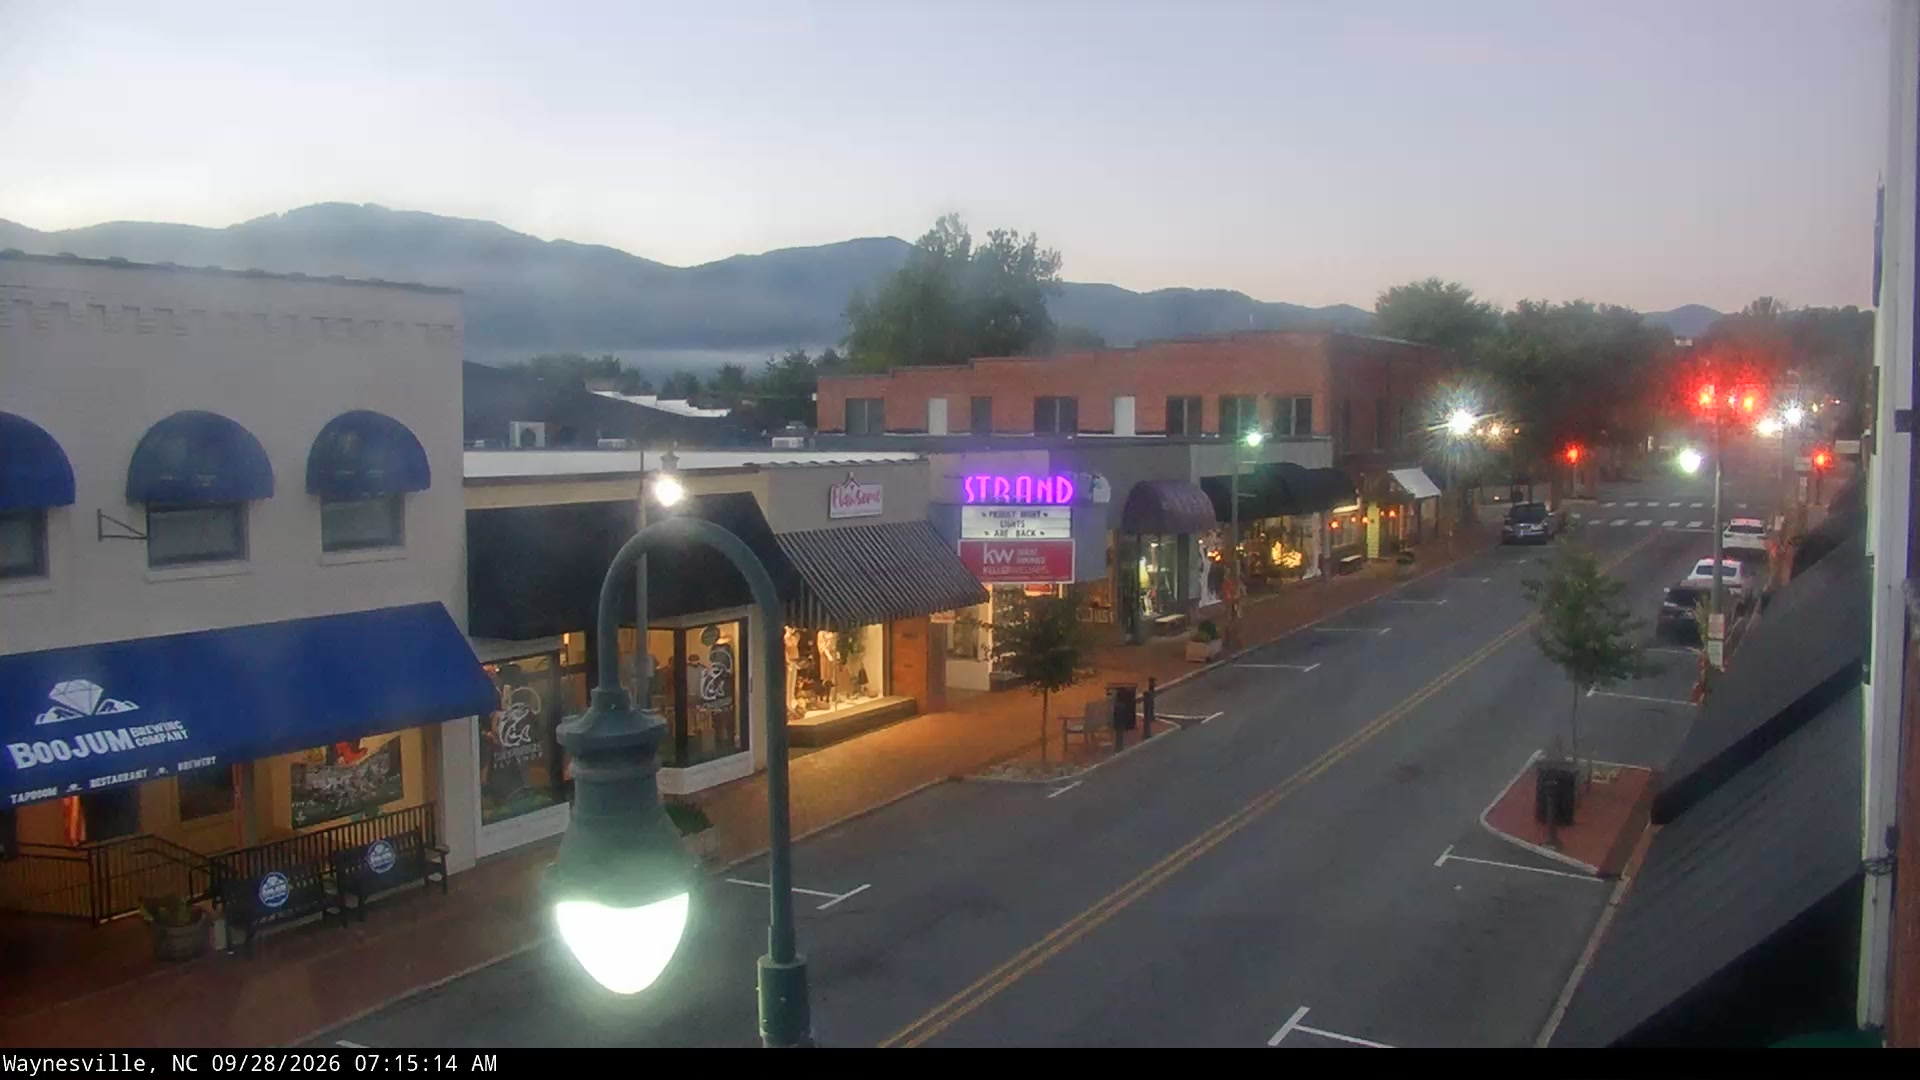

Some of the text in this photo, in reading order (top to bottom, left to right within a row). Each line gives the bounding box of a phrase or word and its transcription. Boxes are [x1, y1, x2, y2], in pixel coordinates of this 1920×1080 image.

[964, 475, 1073, 504] STRAND
[994, 529, 1036, 537] ARE BACK
[1000, 520, 1025, 528] LIGHTS
[983, 543, 1015, 564] kw
[130, 720, 183, 738] BREWING
[135, 729, 189, 747] COMPANY
[89, 769, 148, 789] RESTAURANT
[178, 756, 217, 772] BREWERY
